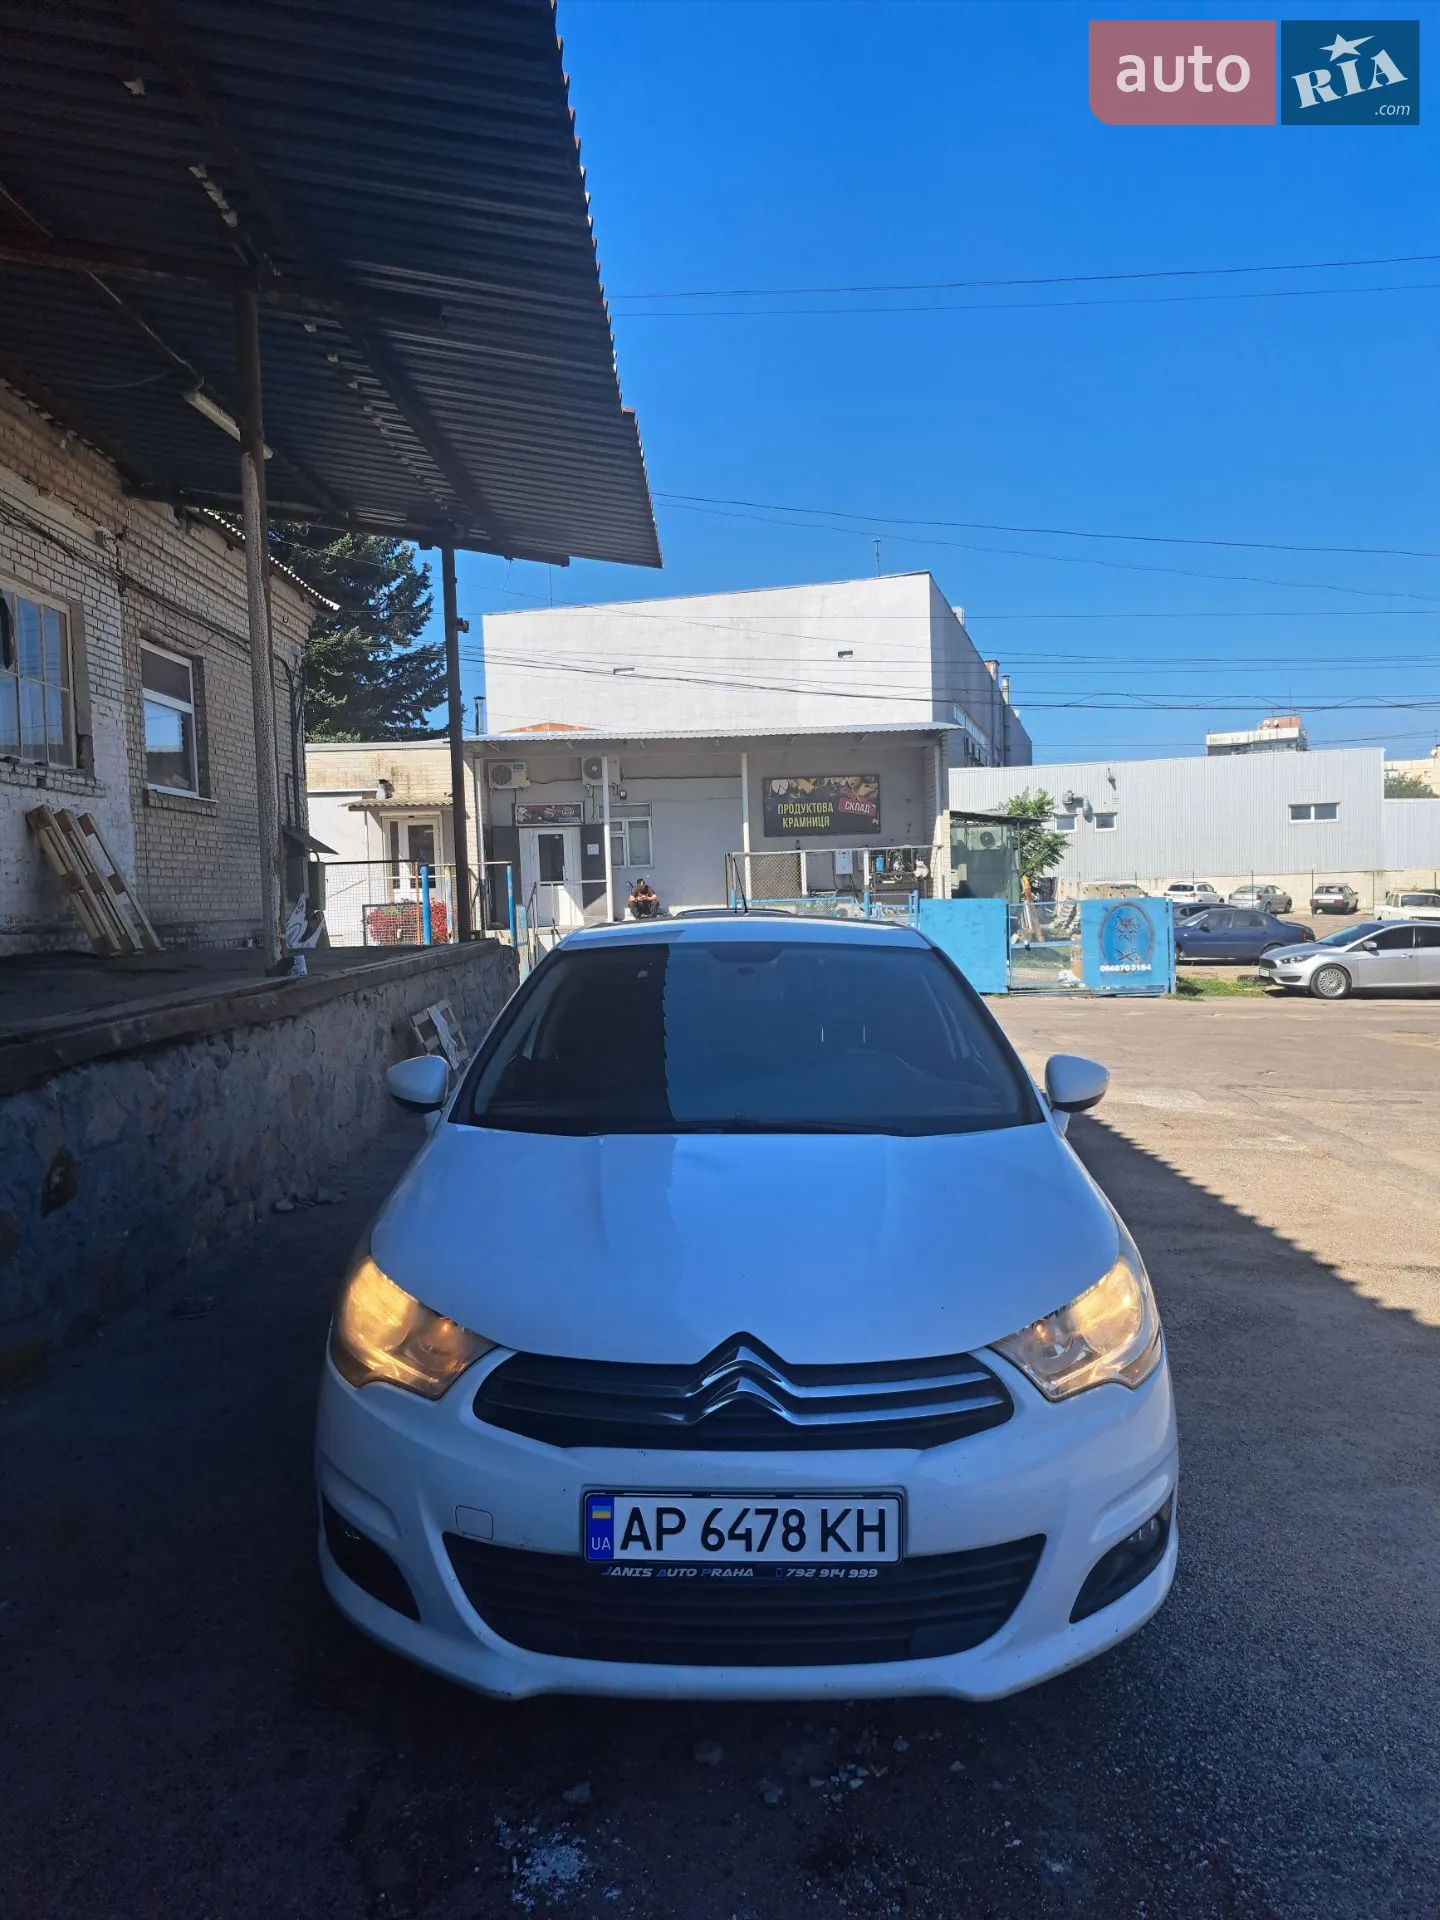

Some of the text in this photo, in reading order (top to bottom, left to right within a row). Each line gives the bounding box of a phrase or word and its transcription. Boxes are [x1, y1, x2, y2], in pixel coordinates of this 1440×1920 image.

[777, 802, 834, 815] ПРОДУКТОВА
[844, 800, 870, 814] СКЛАД
[782, 816, 830, 829] КРАМНИЦЯ
[619, 1507, 886, 1553] AP 6478 KH
[591, 1536, 612, 1551] UA
[602, 1566, 878, 1578] JANIS AUTO PRAHA 792 914 999
